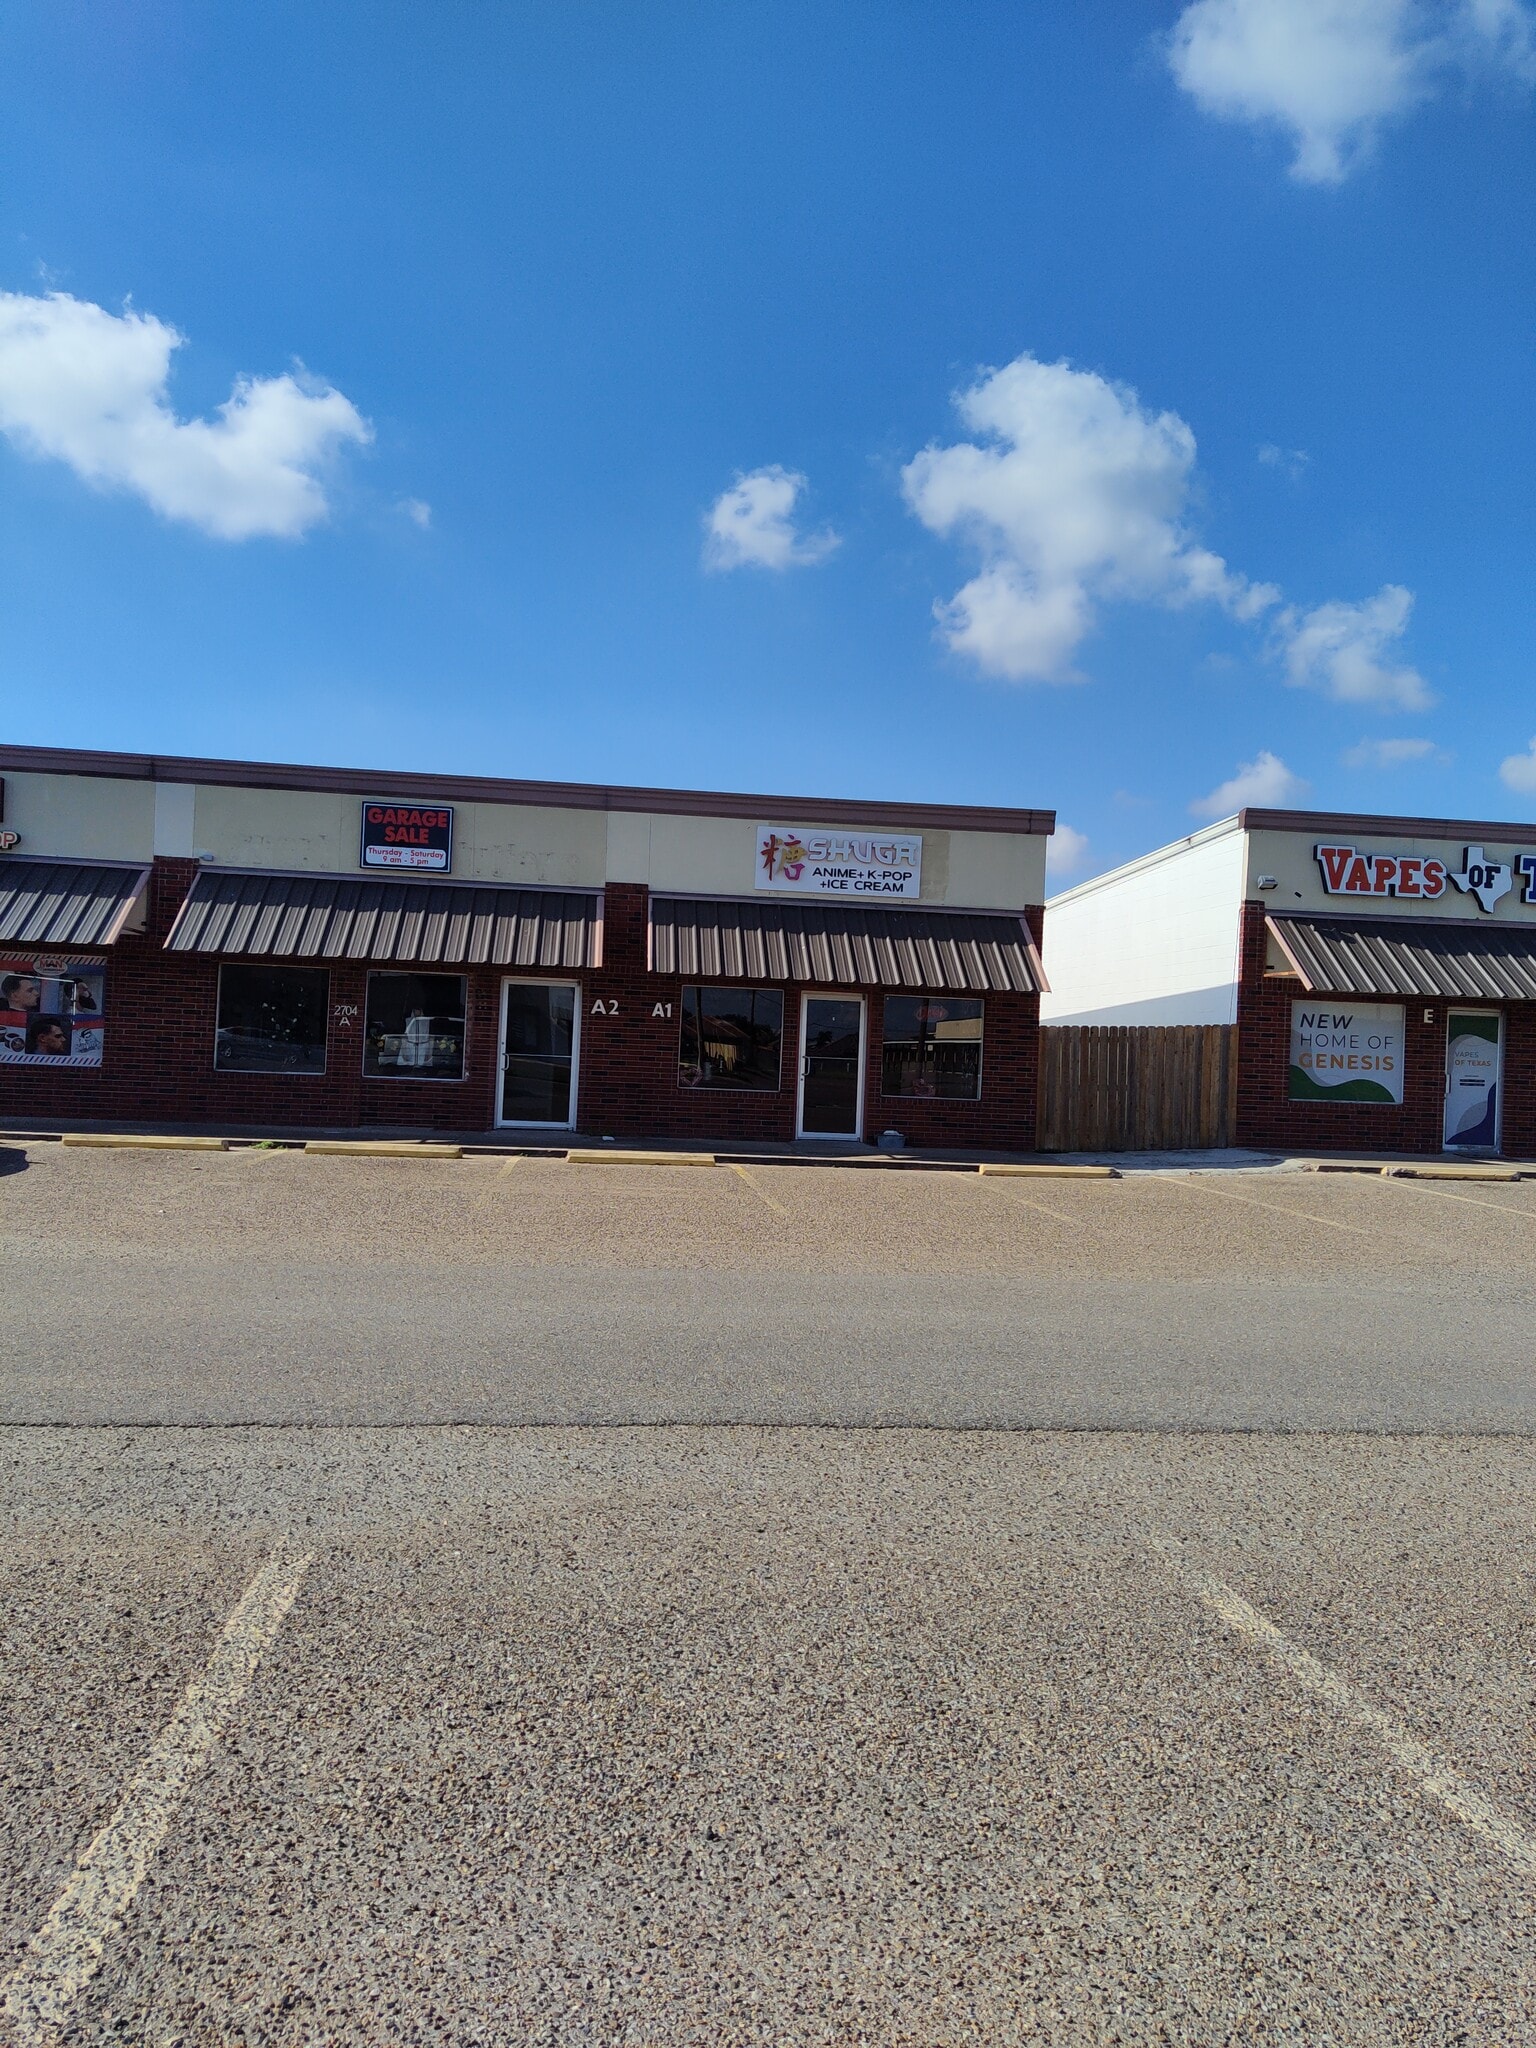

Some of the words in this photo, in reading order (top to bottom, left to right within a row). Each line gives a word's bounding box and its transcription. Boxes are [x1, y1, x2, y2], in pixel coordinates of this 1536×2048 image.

[367, 807, 448, 828] GARAGE
[384, 826, 430, 844] SALE
[368, 847, 403, 857] Thursday
[410, 849, 444, 860] Saturday
[808, 838, 920, 867] SHUGA
[812, 867, 865, 879] ANIME+
[868, 869, 913, 882] K-POP
[1319, 847, 1446, 896] VAPES
[1468, 864, 1501, 889] OF
[820, 879, 849, 890] +ICE
[854, 880, 904, 892] CREAM
[40, 958, 63, 969] MAN
[334, 1005, 358, 1016] 2704
[590, 999, 620, 1015] A2
[651, 1002, 672, 1018] A1
[339, 1016, 351, 1026] A
[1300, 1013, 1354, 1030] NEW
[1423, 1008, 1434, 1024] E
[1300, 1033, 1360, 1049] HOME
[1367, 1035, 1394, 1050] OF
[1298, 1052, 1395, 1071] GENESIS
